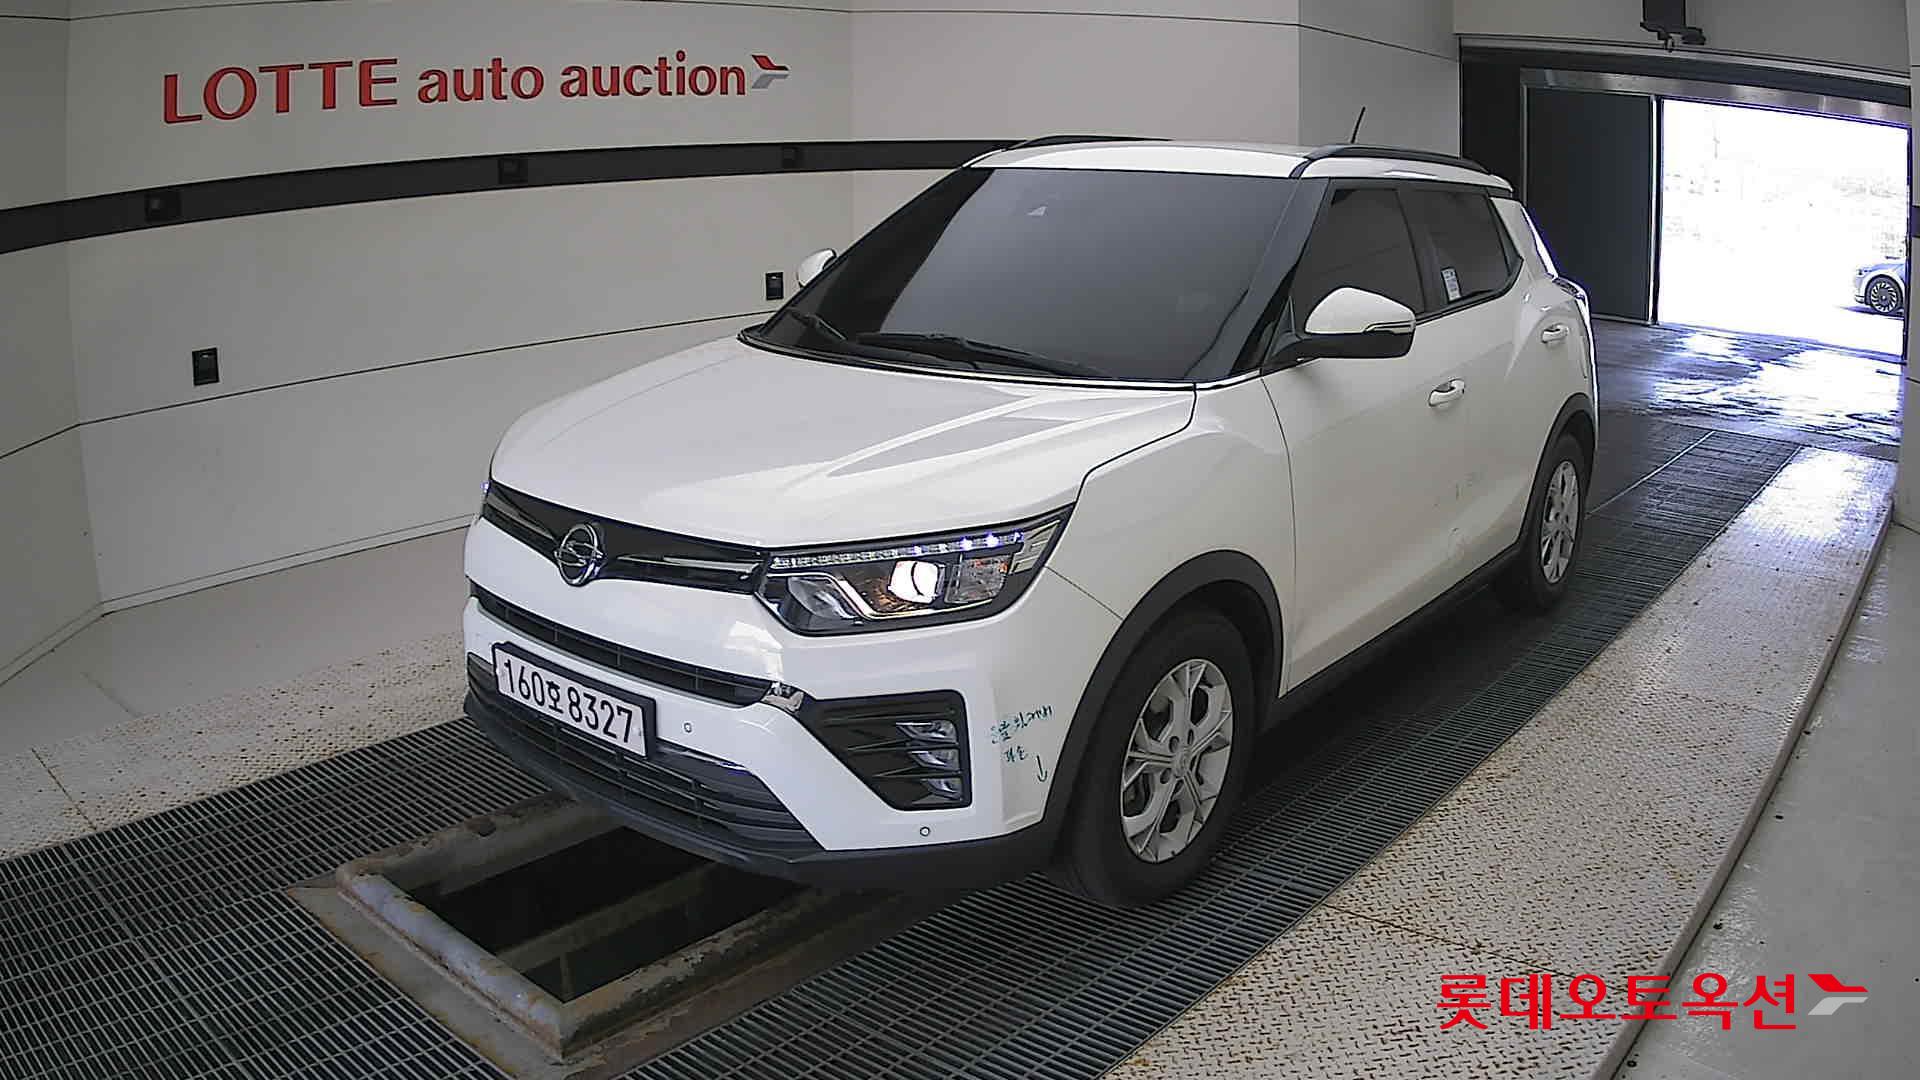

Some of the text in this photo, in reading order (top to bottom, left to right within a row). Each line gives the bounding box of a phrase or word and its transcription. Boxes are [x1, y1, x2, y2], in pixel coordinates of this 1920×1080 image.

[163, 50, 746, 124] LOTTE auto auction
